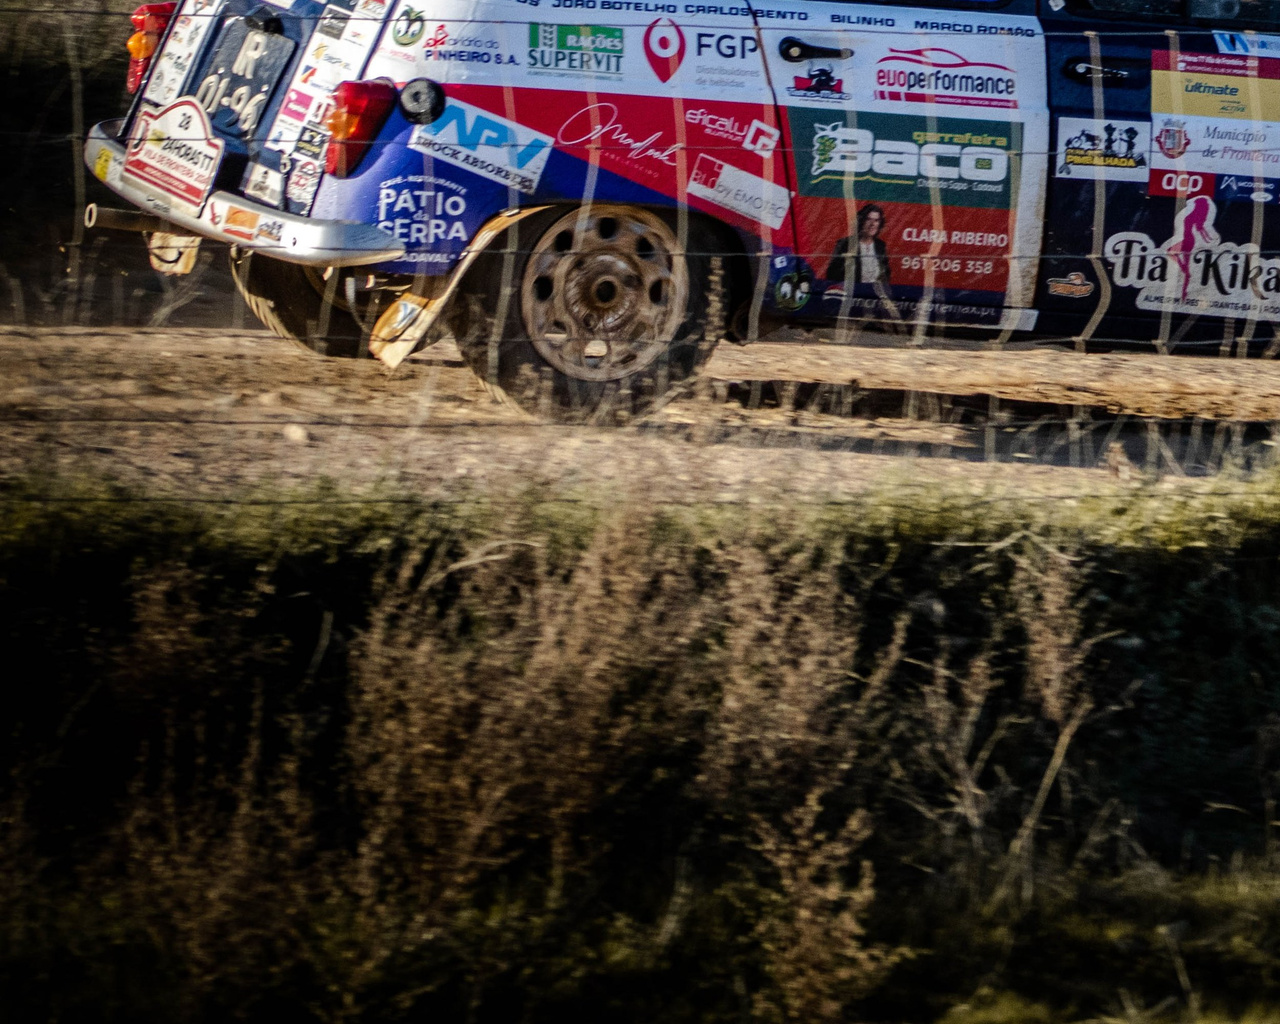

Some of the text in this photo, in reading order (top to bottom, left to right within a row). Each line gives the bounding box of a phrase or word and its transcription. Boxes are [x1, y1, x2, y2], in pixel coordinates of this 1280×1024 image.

[600, 1, 677, 14] BOTELHO
[685, 4, 809, 22] CARLOS BENTO
[830, 14, 895, 28] BILINHO
[914, 20, 973, 34] MARCO
[566, 34, 623, 50] RAÇÕES
[696, 32, 759, 59] FGP
[425, 50, 491, 64] PINHEIRO
[527, 49, 623, 73] SUPERVIT
[1185, 81, 1239, 96] ultimate
[912, 131, 1007, 147] garrafeira
[1203, 126, 1267, 145] Município
[416, 135, 535, 191] SHOCK ABSORBERS
[811, 126, 1009, 182] Baco
[1202, 145, 1280, 164] de Fronteira
[1161, 173, 1203, 193] acp
[379, 188, 467, 221] PÁTIO
[413, 210, 430, 221] da
[377, 219, 468, 244] SERRA
[902, 227, 1009, 248] CLARA RIBEIRO
[394, 252, 452, 263] ADAVAL
[901, 256, 993, 274] 961 206 358
[1111, 238, 1169, 283] Tia
